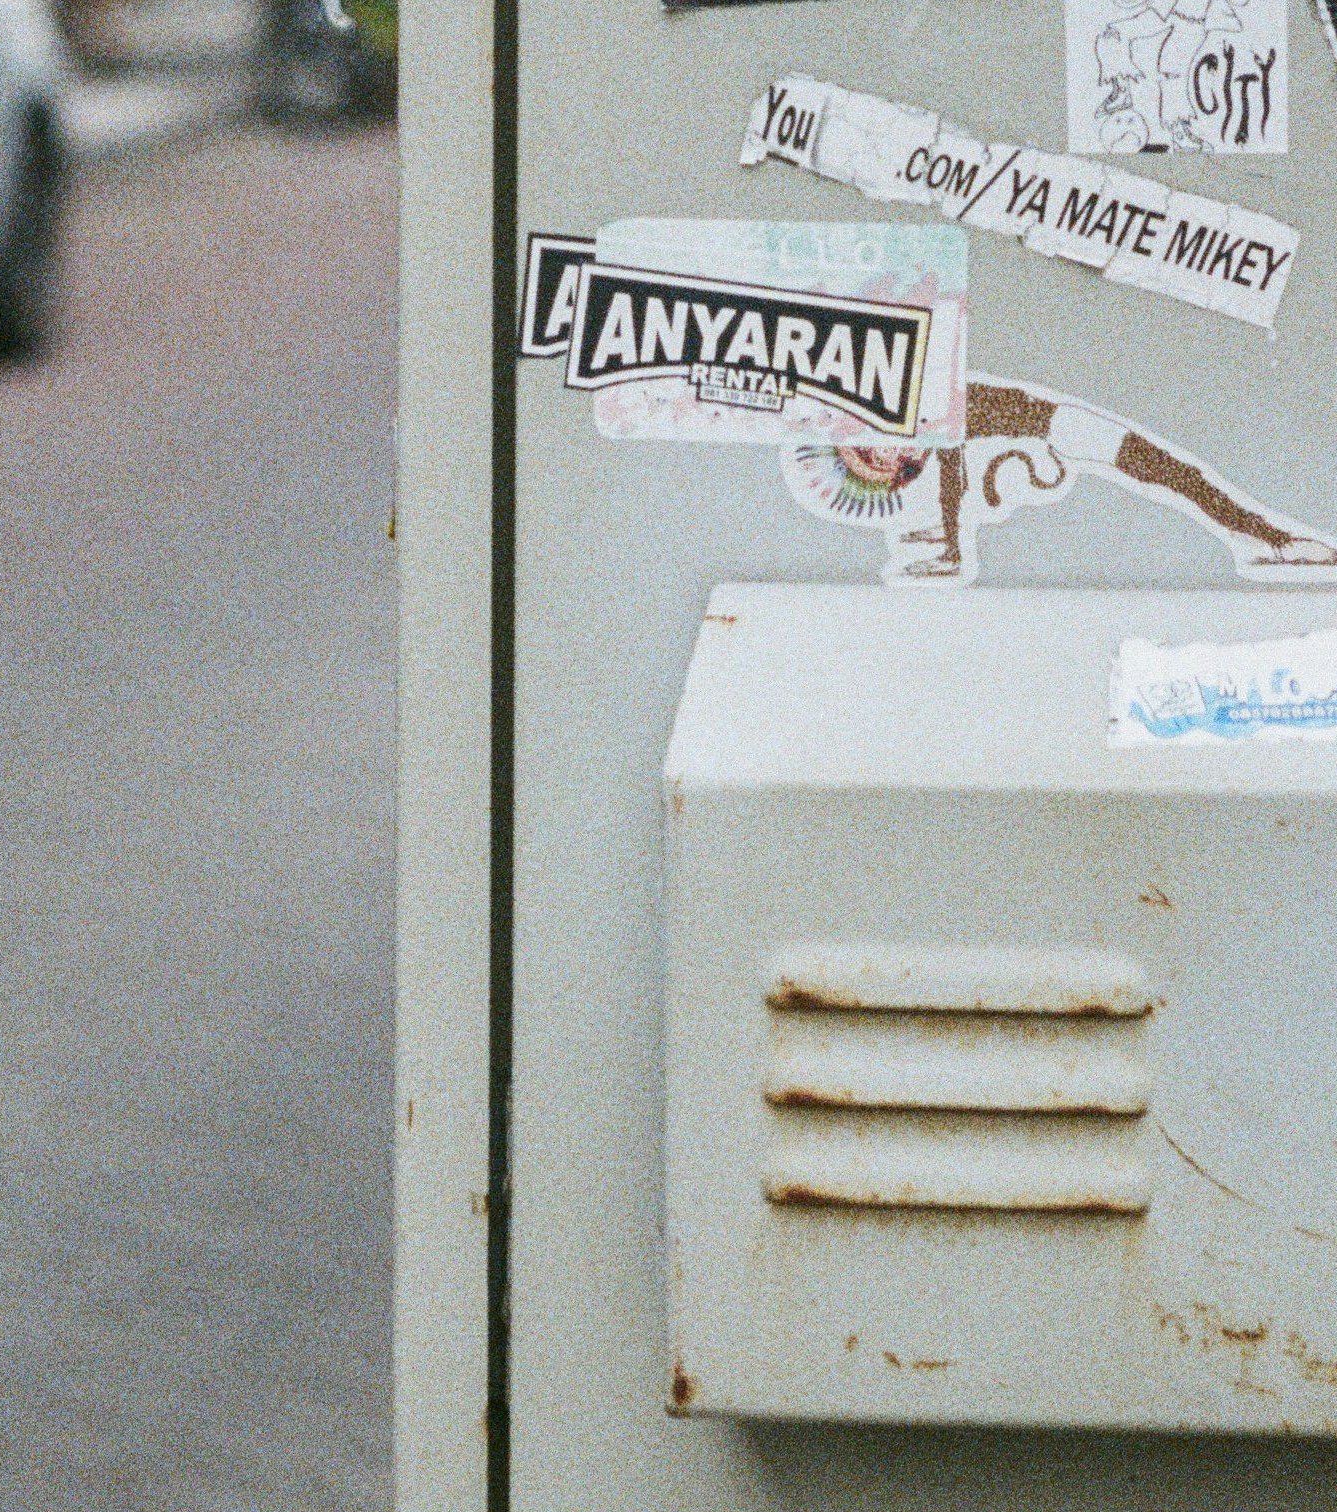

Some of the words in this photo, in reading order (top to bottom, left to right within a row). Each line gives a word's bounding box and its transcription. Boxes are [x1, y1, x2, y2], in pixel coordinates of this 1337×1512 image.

[1192, 39, 1277, 148] CITY
[763, 84, 815, 150] You
[1056, 186, 1166, 257] MATE
[1164, 218, 1292, 292] MIKEY
[590, 290, 911, 415] ANYARAN
[690, 363, 796, 398] RENTAL
